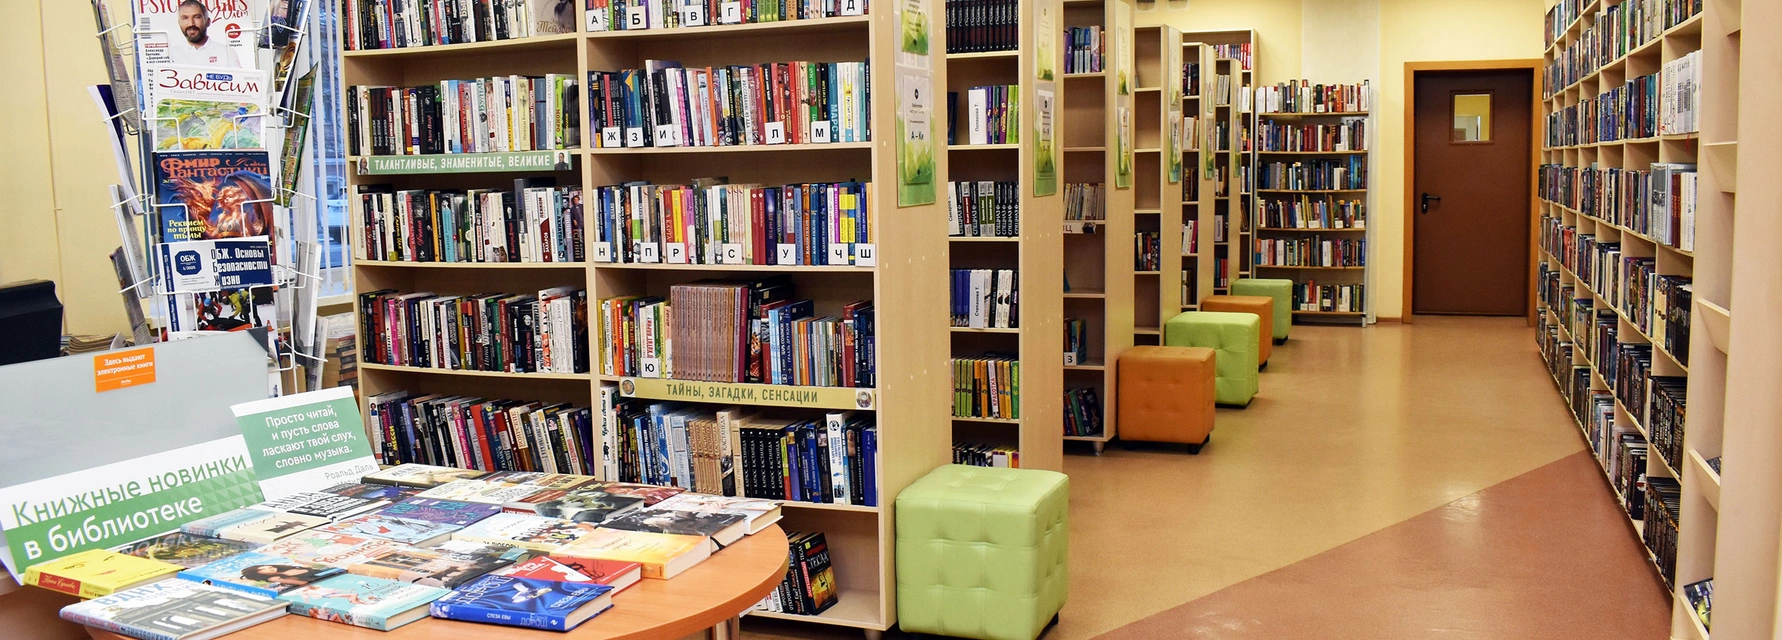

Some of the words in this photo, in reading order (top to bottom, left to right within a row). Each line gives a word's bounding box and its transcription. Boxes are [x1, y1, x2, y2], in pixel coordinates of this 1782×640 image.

[846, 0, 855, 11] Д
[691, 12, 698, 21] В
[728, 7, 734, 17] Г
[591, 16, 599, 25] А
[632, 13, 640, 25] Б
[159, 69, 259, 93] Зависим
[477, 80, 485, 112] ВУЛЬФ
[607, 131, 616, 141] Ж
[660, 128, 666, 138] И
[772, 128, 779, 139] Л
[816, 128, 824, 138] М
[188, 158, 220, 167] МИР
[375, 159, 438, 170] ТАЛАНТЛИВЫЕ,
[441, 157, 504, 169] ЗНАМЕНИТЫЕ,
[508, 155, 550, 167] ВЕЛИКИЕ
[211, 248, 232, 259] ОБЖ.
[235, 247, 264, 258] Основы
[599, 247, 605, 256] Н
[645, 248, 652, 257] П
[673, 248, 680, 258] Р
[728, 249, 735, 258] С
[782, 250, 789, 259] У
[836, 250, 842, 259] Ч
[861, 250, 871, 259] Ш
[213, 261, 268, 272] Безопасности
[104, 356, 123, 366] Здесь
[124, 354, 146, 364] выдают
[97, 362, 136, 376] электронные
[136, 361, 154, 370] книги
[645, 364, 654, 372] Ю
[667, 384, 704, 399] ТАЙНЫ,
[709, 386, 757, 402] ЗАГАДКИ,
[762, 389, 818, 403] СЕНСАЦИИ
[265, 413, 305, 428] Просто
[306, 404, 338, 419] читай,
[271, 432, 279, 441] и
[281, 425, 310, 440] пусть
[311, 420, 340, 433] слова
[262, 441, 305, 457] ласкают
[307, 434, 330, 449] твой
[331, 430, 357, 444] слух,
[275, 453, 313, 469] словно
[314, 445, 353, 462] музыка.
[324, 468, 355, 480] Роальд
[355, 462, 374, 475] Даль
[12, 481, 142, 528] Книжные
[148, 454, 249, 497] новинки
[24, 541, 42, 560] в
[50, 496, 203, 550] библиотеке
